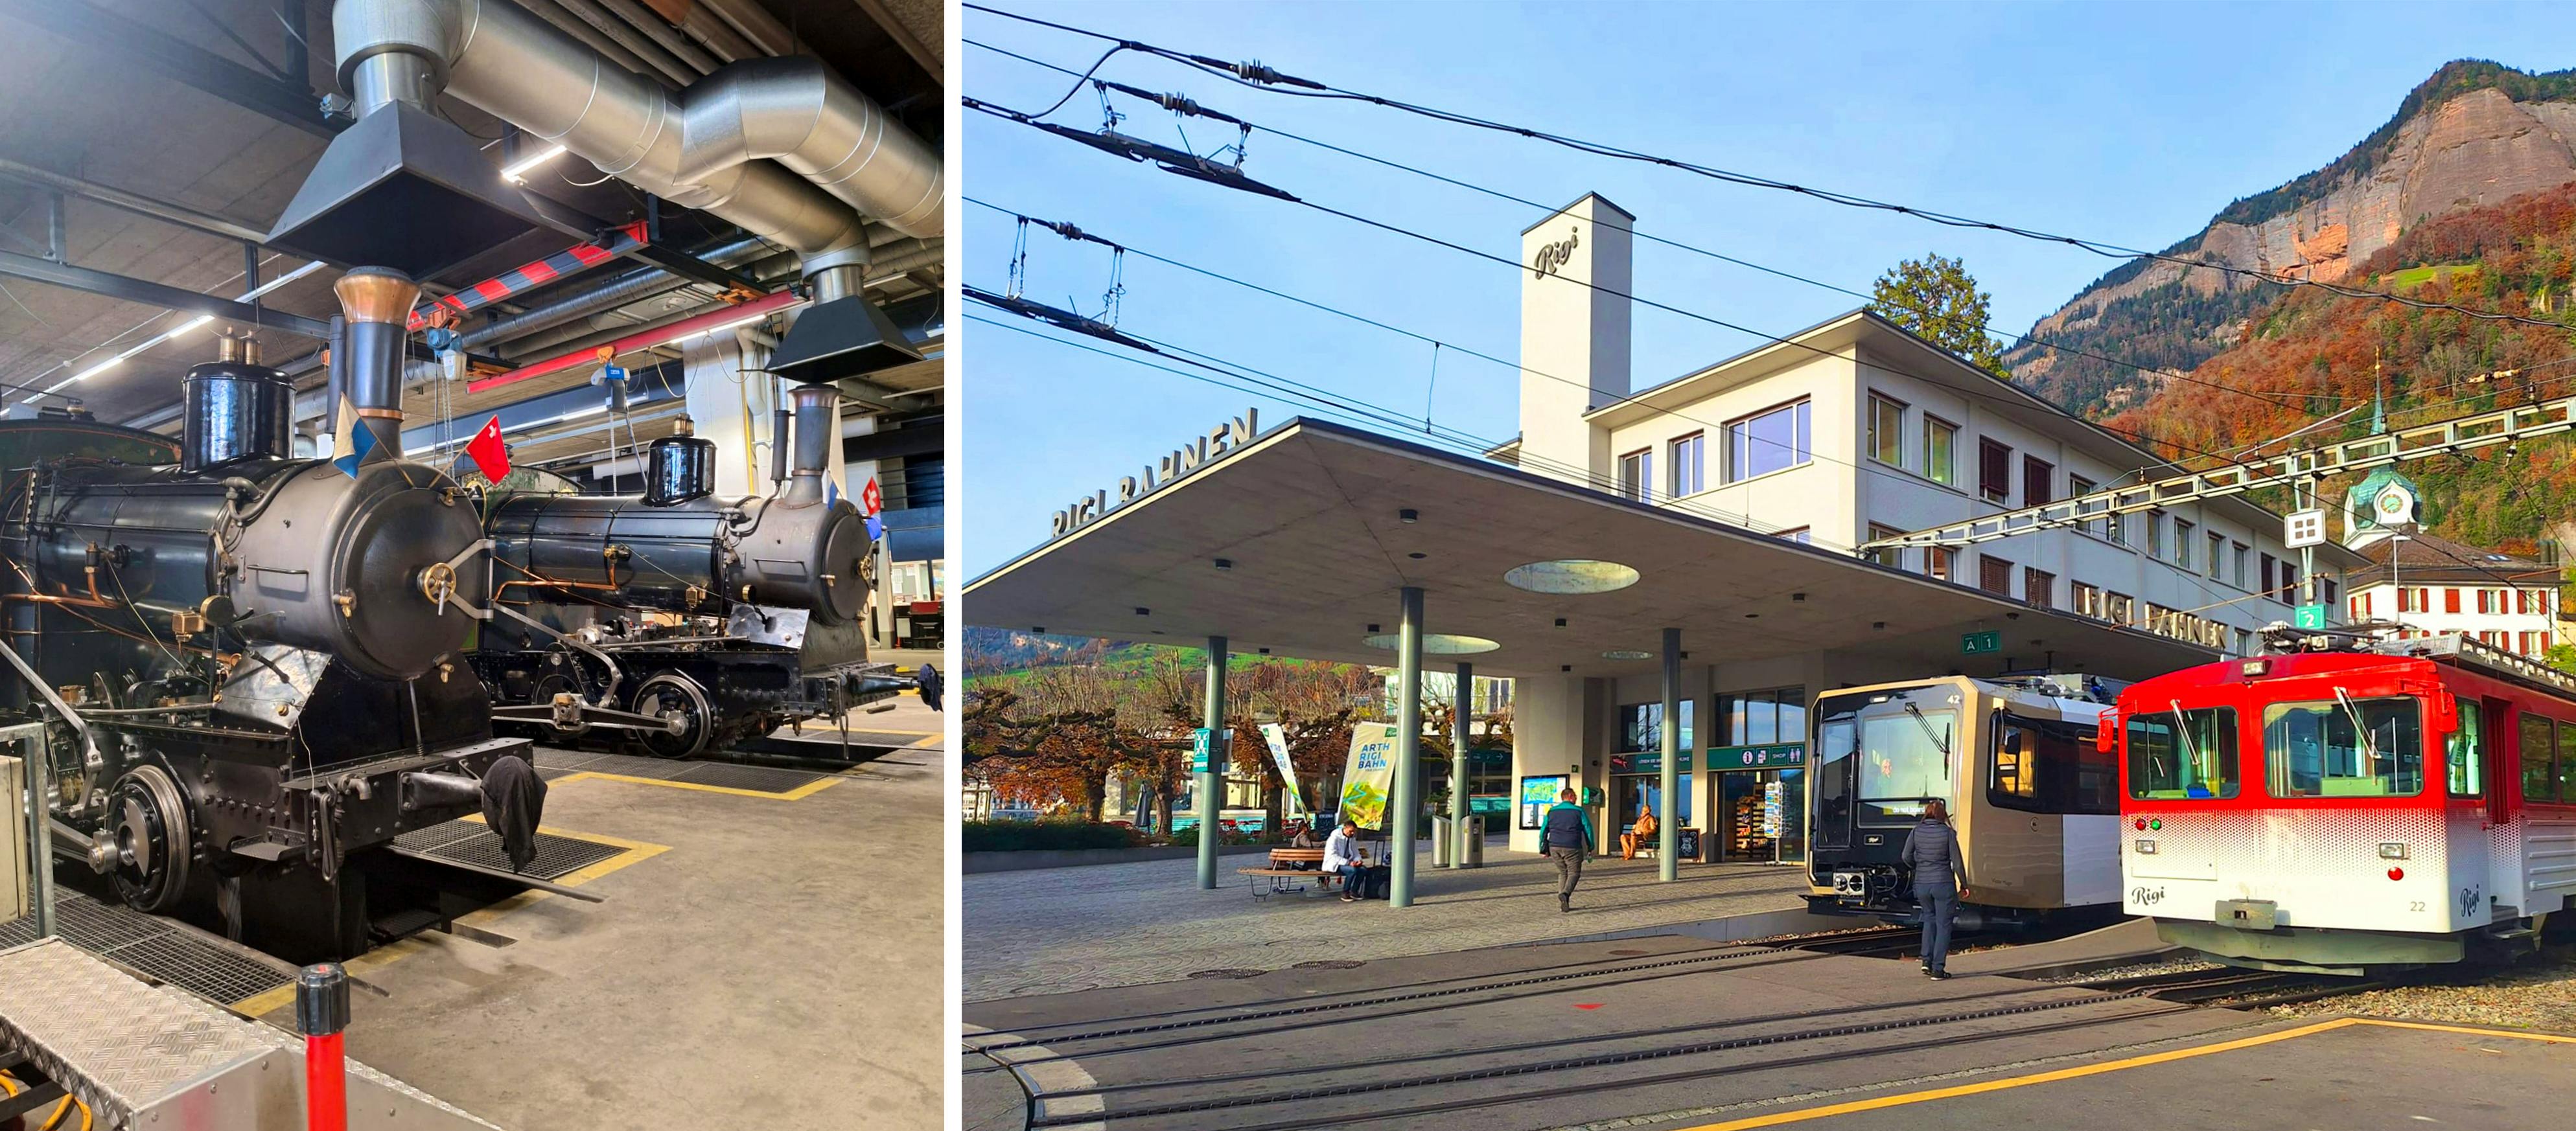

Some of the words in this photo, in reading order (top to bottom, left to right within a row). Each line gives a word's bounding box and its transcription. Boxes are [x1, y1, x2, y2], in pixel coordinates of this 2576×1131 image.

[1534, 225, 1579, 280] Rigi
[1052, 489, 1106, 538] RIGI
[1119, 407, 1258, 503] BAHNEN
[2084, 587, 2135, 627] RIGI
[2144, 604, 2227, 650] BAHNEN
[2304, 613, 2315, 627] 2
[1966, 640, 1976, 651] A
[1986, 637, 1991, 648] 1
[1947, 694, 1960, 704] 42
[1362, 743, 1390, 752] ARTH
[1360, 751, 1381, 760] RIGI
[1358, 759, 1387, 769] BAHN
[2131, 886, 2164, 906] Rigi
[2460, 884, 2479, 917] Rigi
[2410, 901, 2426, 912] 22
